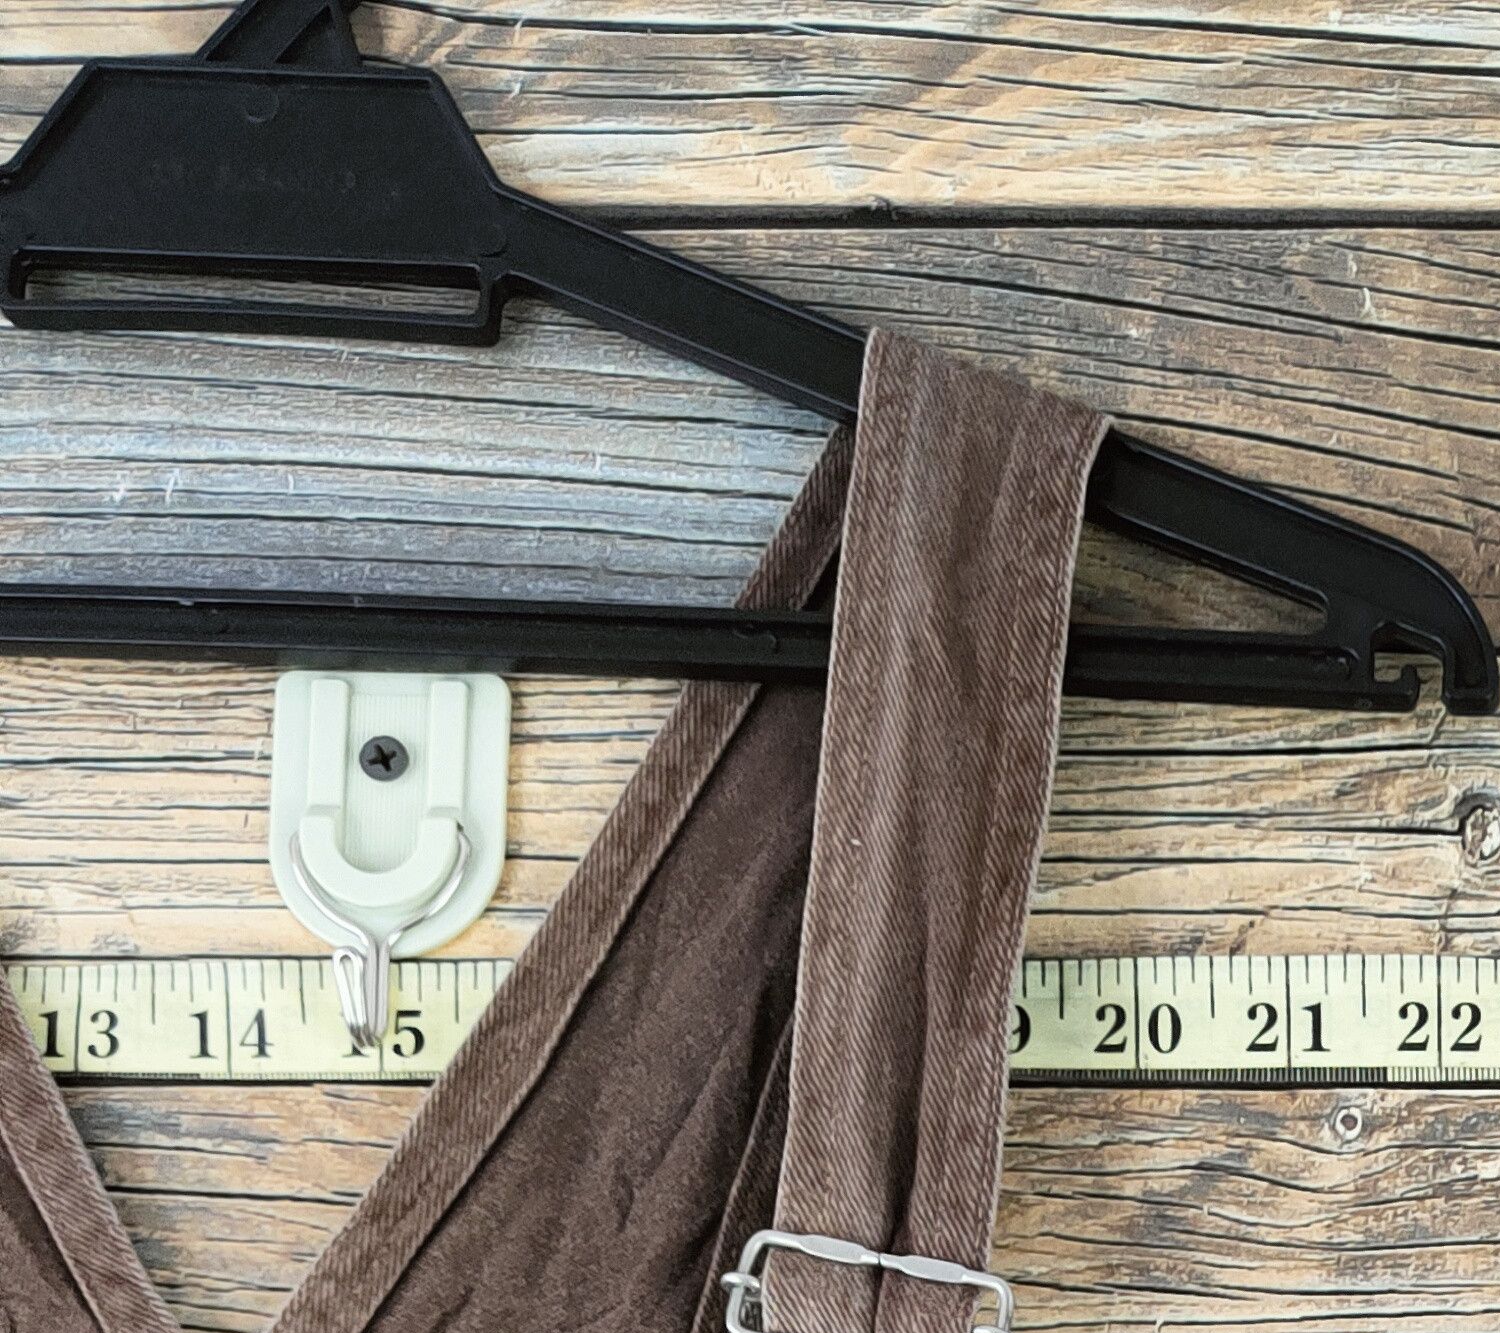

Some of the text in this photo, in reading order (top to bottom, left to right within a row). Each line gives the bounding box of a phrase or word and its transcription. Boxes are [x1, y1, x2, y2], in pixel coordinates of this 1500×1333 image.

[38, 1009, 120, 1059] 13
[188, 1009, 273, 1060] 14
[1093, 1002, 1183, 1055] 20
[1245, 1001, 1332, 1053] 21
[1396, 1001, 1484, 1053] 22
